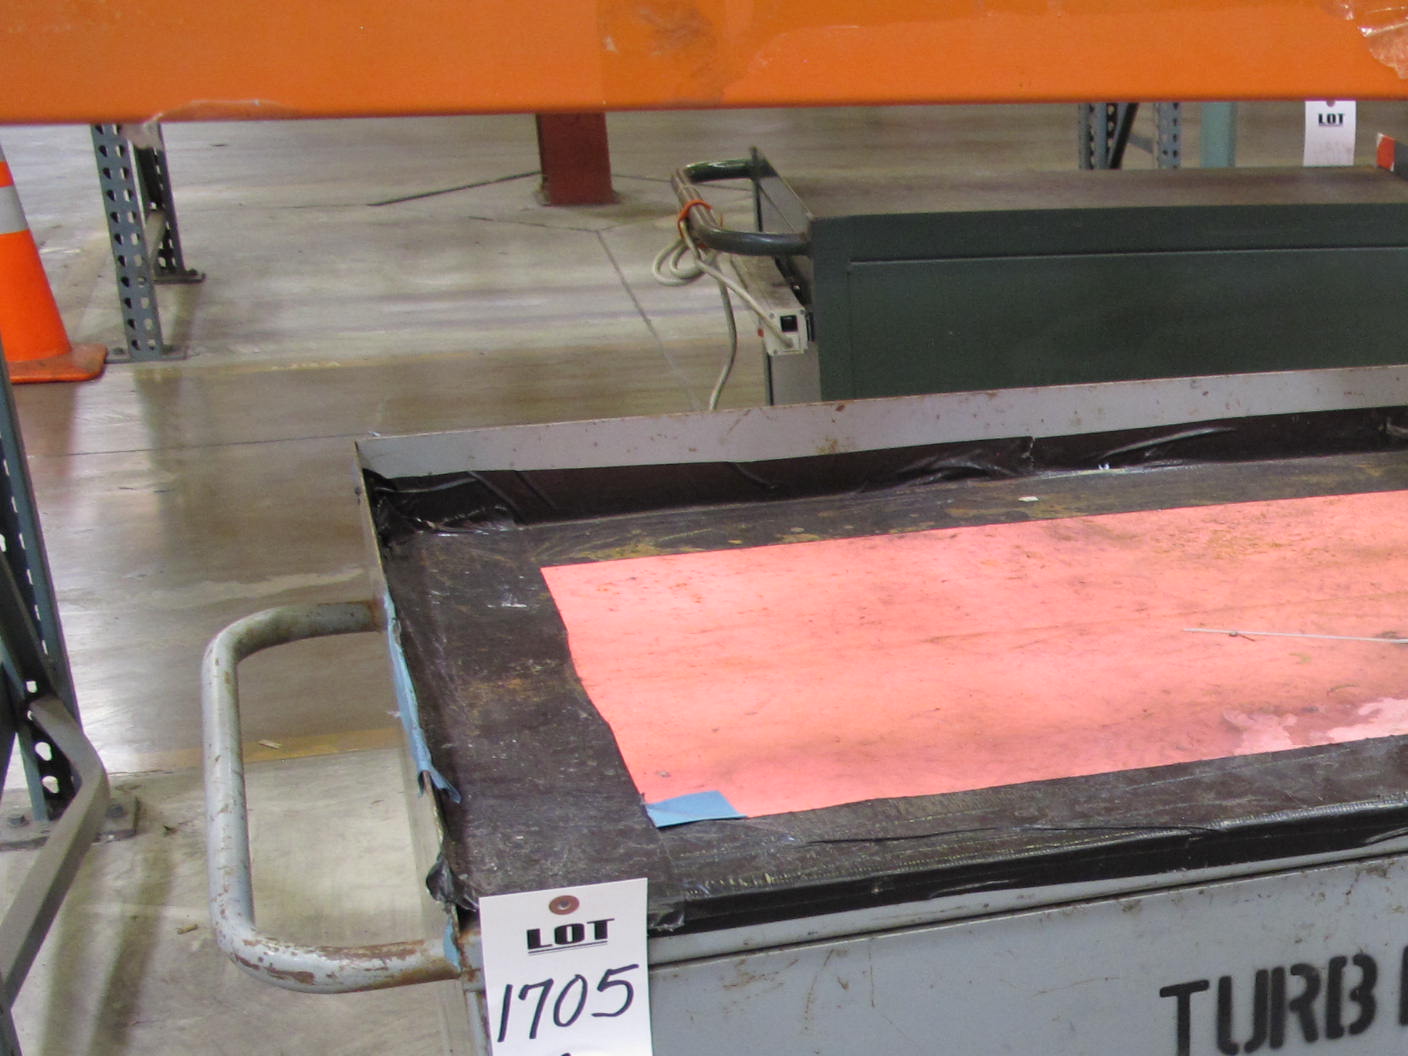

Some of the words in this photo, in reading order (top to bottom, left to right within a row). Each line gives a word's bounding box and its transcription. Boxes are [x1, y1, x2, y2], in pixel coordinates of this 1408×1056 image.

[1318, 113, 1345, 125] LOT
[526, 918, 615, 950] LOT
[497, 963, 639, 1043] 1705
